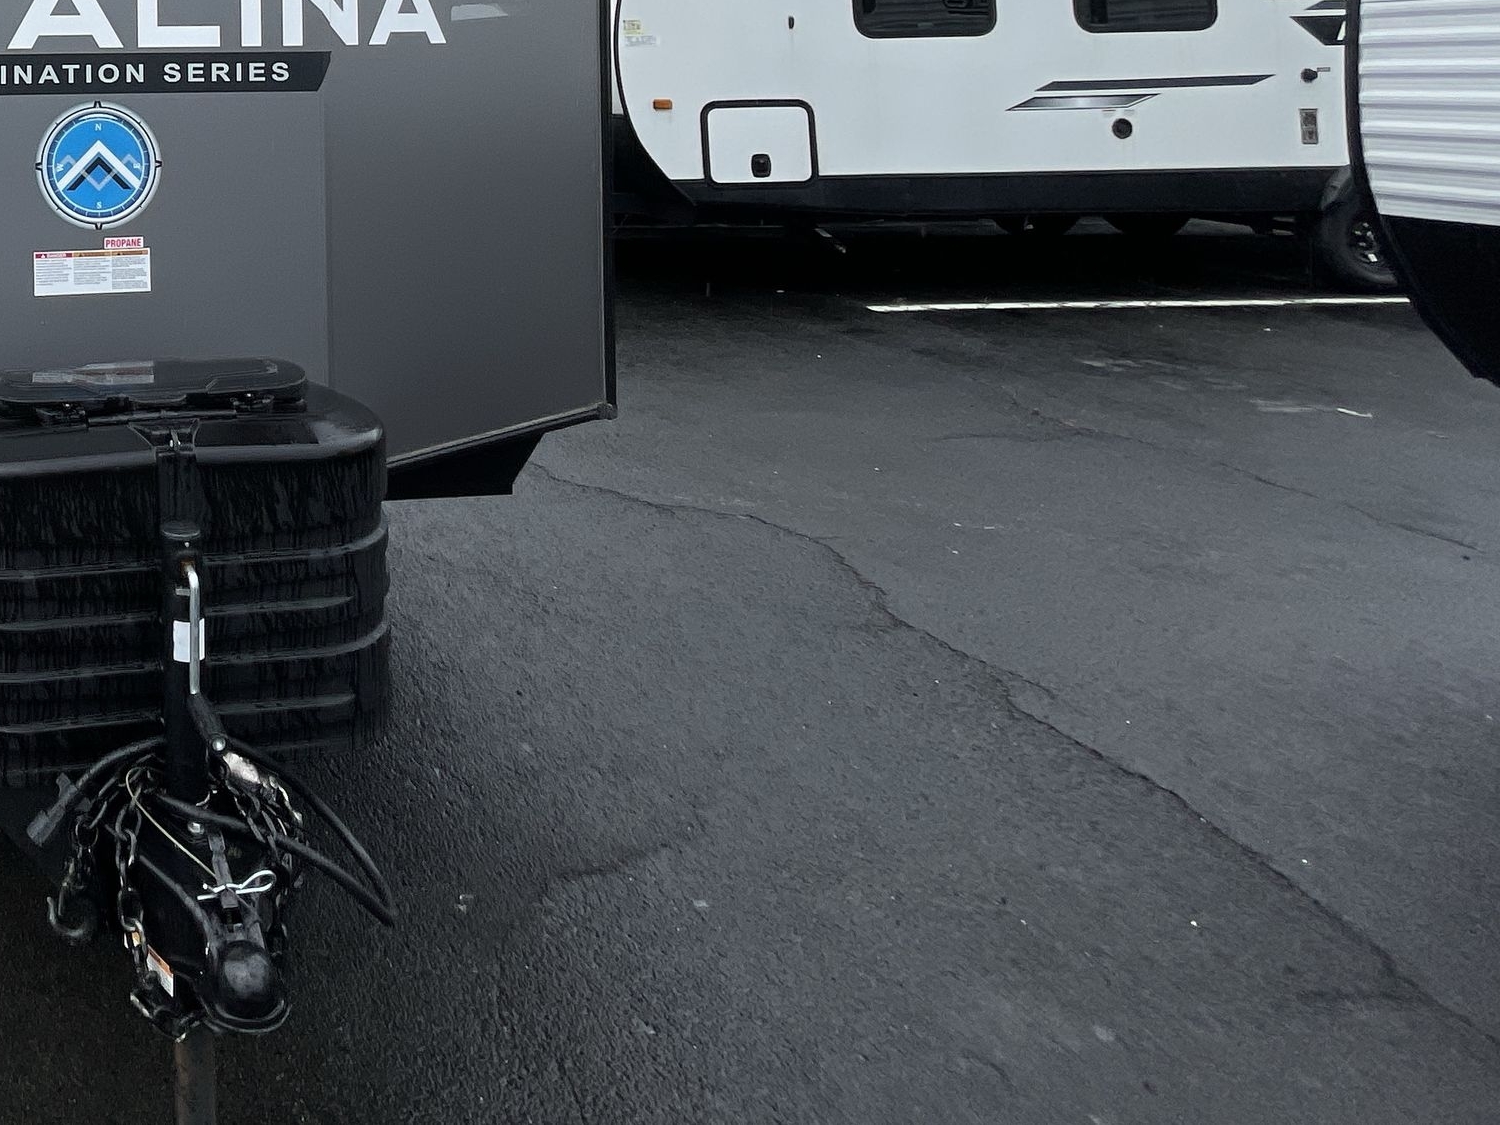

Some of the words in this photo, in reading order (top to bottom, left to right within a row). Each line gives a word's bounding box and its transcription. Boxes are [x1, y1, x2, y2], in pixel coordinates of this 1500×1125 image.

[163, 62, 290, 83] SERIES
[94, 123, 102, 131] N
[96, 201, 102, 209] S
[105, 238, 142, 248] PROPANE
